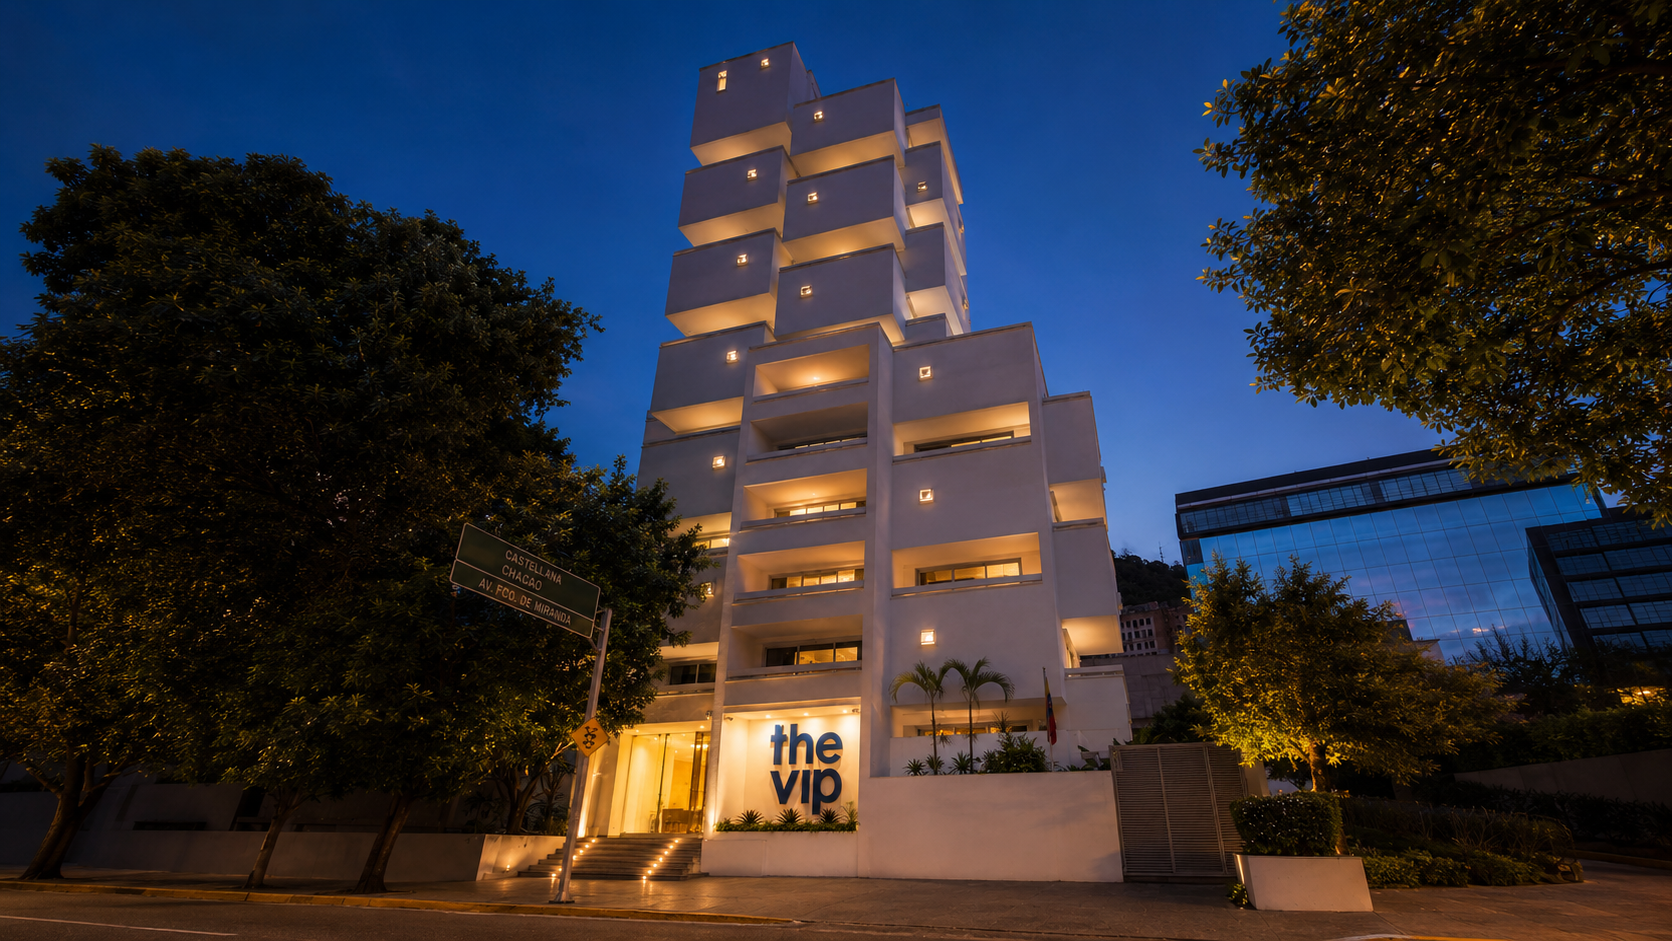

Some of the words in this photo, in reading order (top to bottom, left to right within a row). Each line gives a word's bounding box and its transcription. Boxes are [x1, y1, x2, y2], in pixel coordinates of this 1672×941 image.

[501, 564, 543, 591] CHACAO
[505, 549, 562, 585] CASTELLANA
[478, 578, 493, 593] AV.
[495, 584, 517, 602] FCO.
[519, 594, 532, 608] DE
[534, 601, 571, 625] MIRANDA
[771, 724, 843, 765] the
[770, 768, 842, 815] vip
